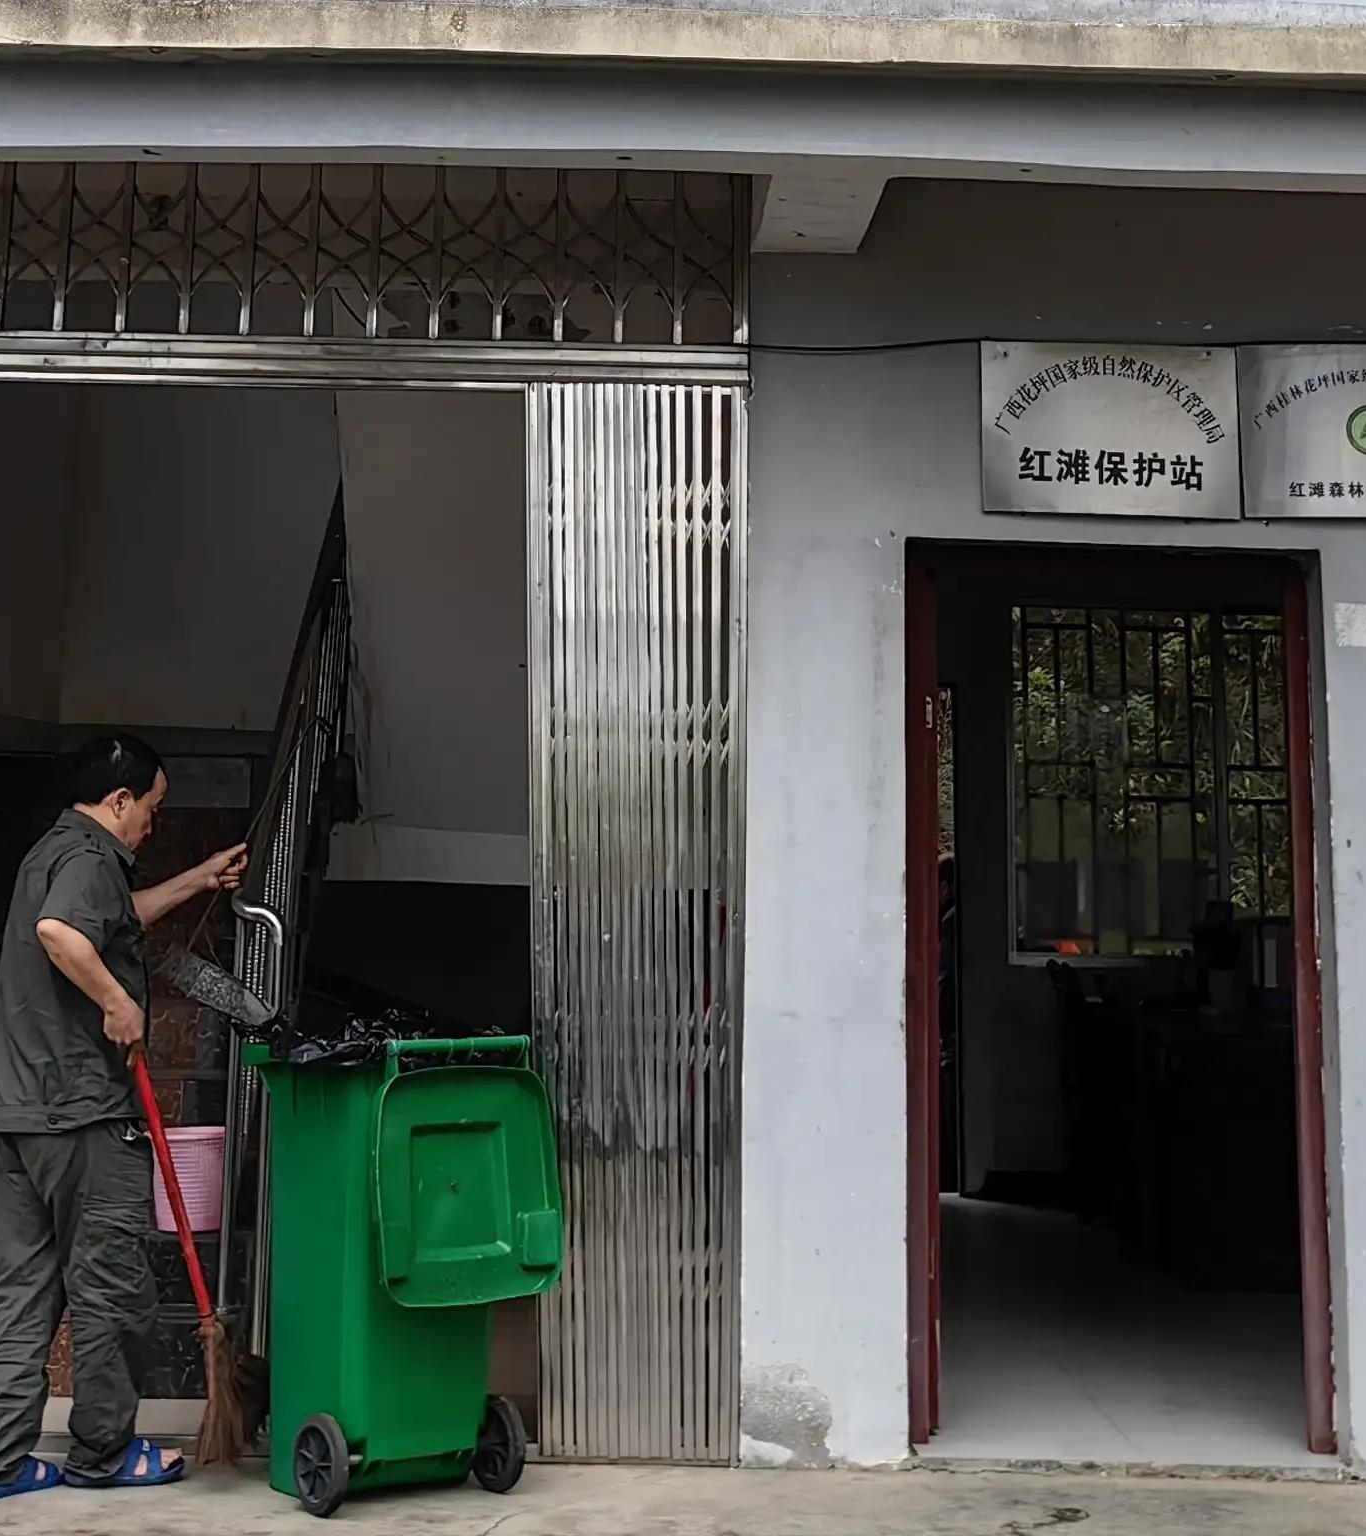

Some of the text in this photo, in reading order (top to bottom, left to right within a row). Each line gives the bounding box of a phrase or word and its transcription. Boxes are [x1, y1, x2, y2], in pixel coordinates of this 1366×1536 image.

[994, 354, 1226, 445] 广西花坪国家级自然保护区管理局
[1018, 446, 1204, 492] 红滩保护站
